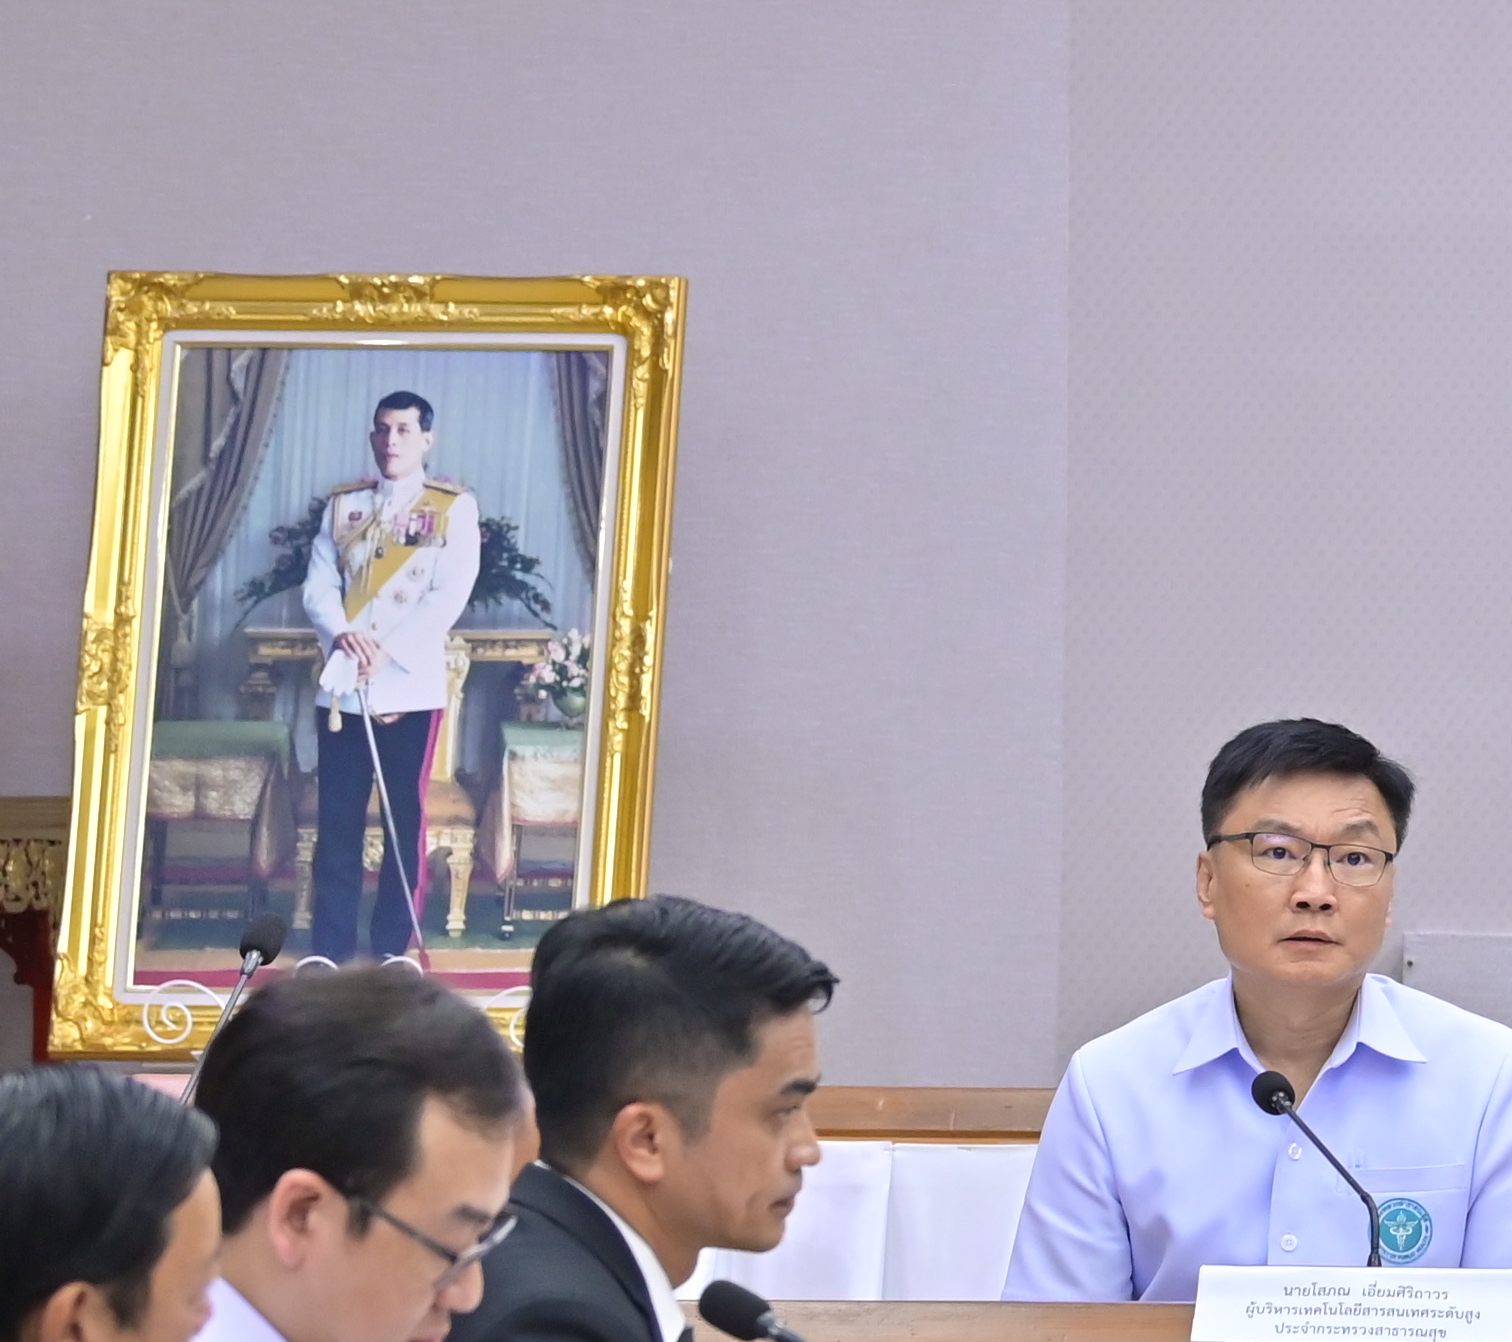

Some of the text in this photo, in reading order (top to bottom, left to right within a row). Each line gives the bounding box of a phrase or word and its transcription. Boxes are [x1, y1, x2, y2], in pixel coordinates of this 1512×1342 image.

[1283, 1281, 1449, 1301] นายโสภณ เอี่ยมศิริถาวร
[1245, 1301, 1481, 1324] ผู้บริหารเทคโนโลยีสารสนเทศระดับสูง
[1274, 1322, 1447, 1342] ประจำกระทรวงสาธารณสุข
